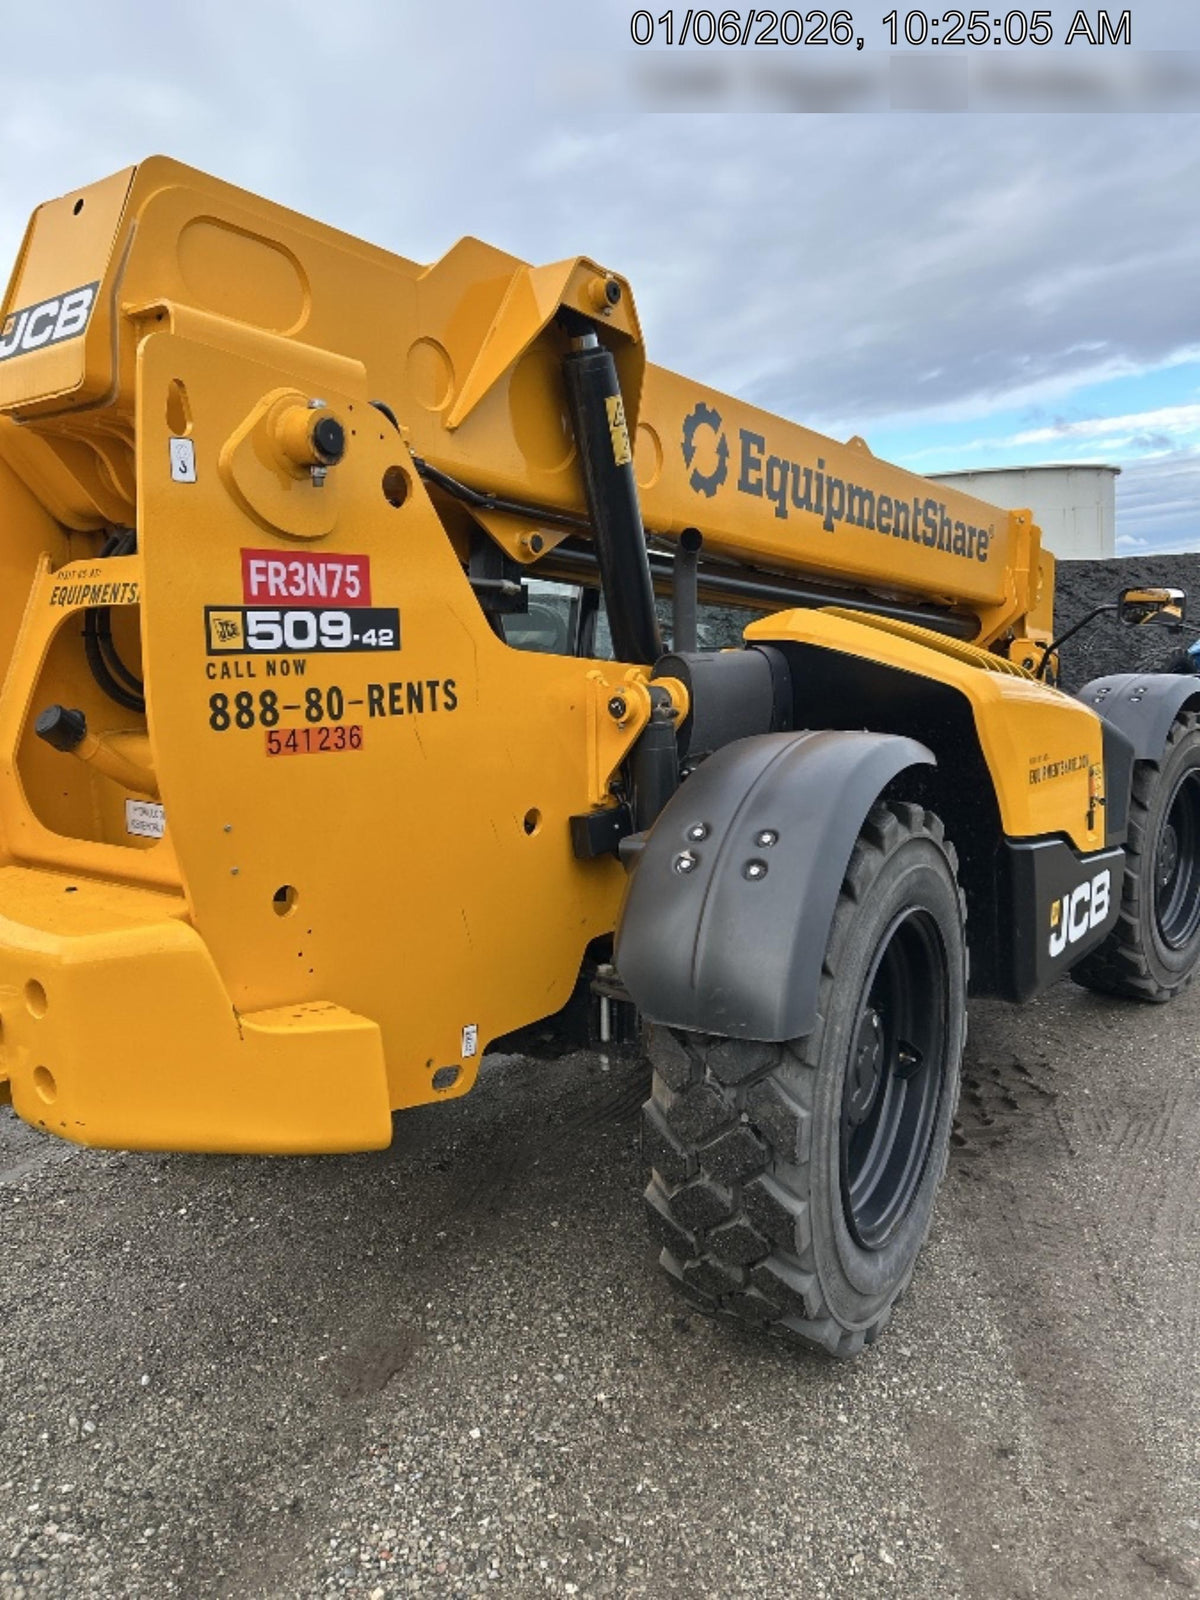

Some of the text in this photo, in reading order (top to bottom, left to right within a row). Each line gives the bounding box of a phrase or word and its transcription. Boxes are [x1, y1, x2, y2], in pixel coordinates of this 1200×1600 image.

[0, 287, 94, 359] JCB
[49, 582, 141, 607] EQUIPMENTS
[249, 559, 361, 598] FR3N75
[206, 659, 307, 680] CALL NOW
[208, 678, 458, 732] 888-80-RENTS
[267, 725, 362, 755] 541236
[1048, 868, 1111, 958] JCB
